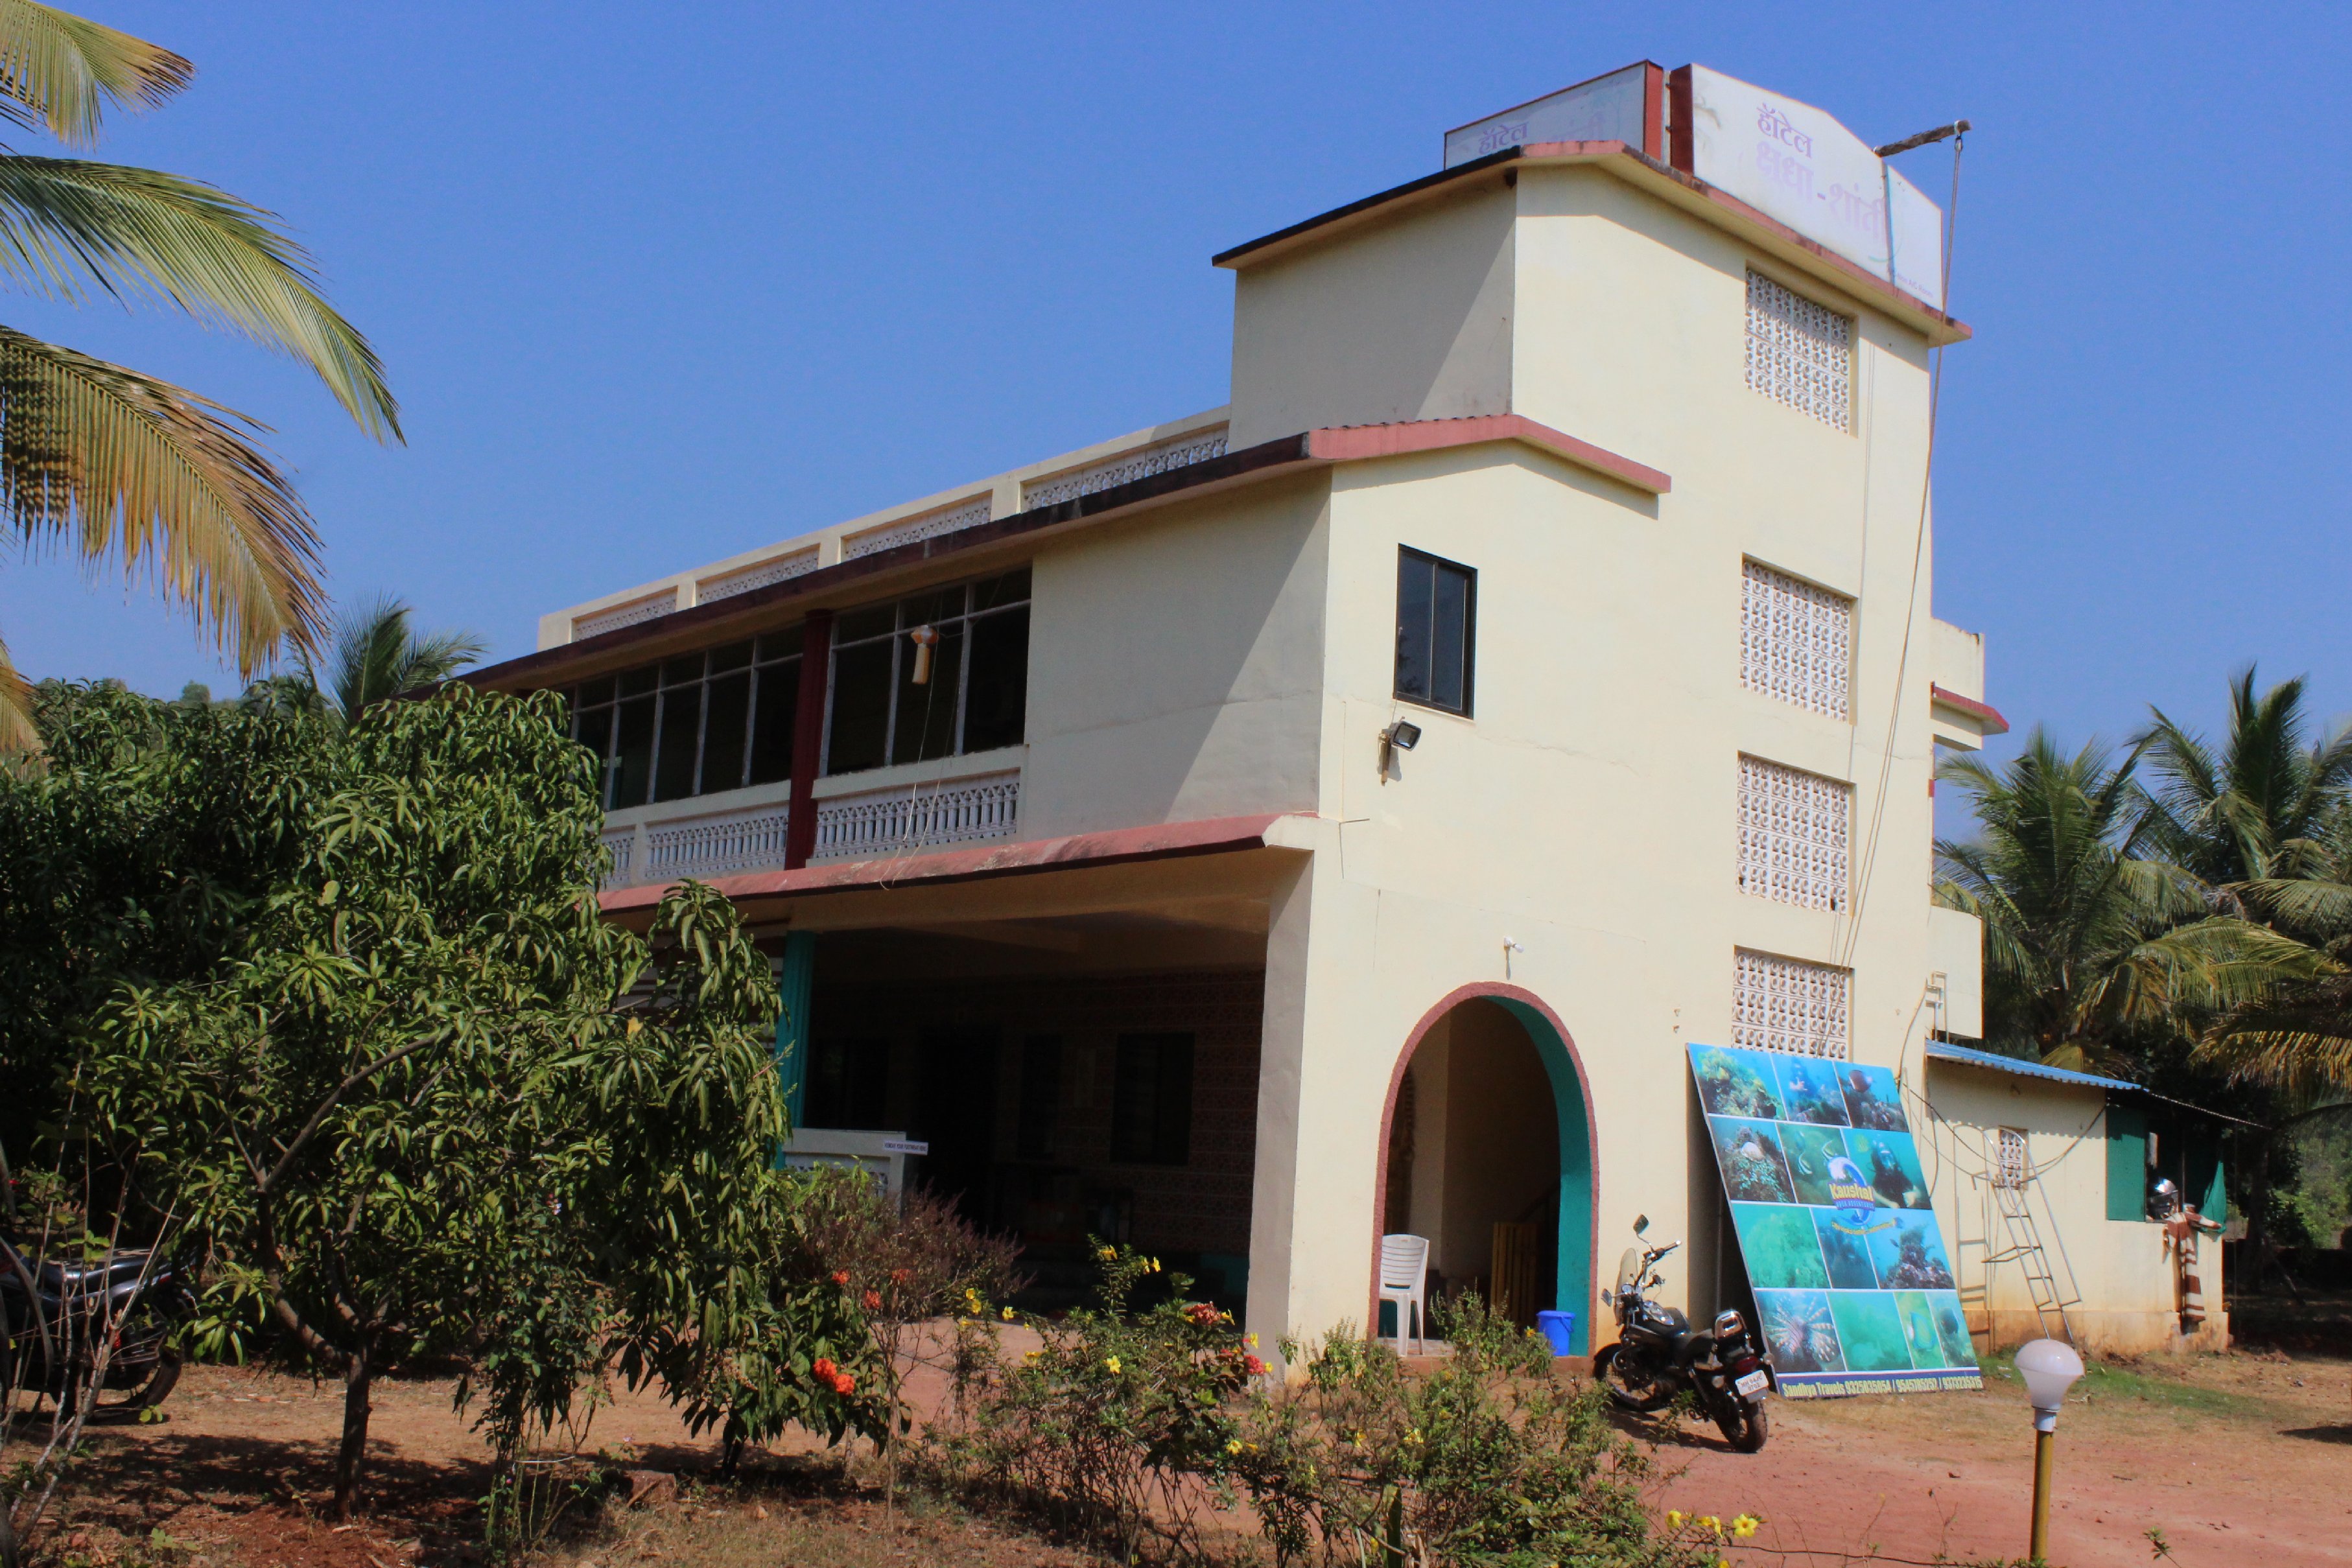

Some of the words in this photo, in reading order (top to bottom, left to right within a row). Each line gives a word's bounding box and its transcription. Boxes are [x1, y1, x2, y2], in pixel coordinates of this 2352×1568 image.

[1756, 102, 1813, 159] हॉटेल
[1828, 1182, 1875, 1202] Kaushal
[1782, 1382, 1817, 1398] Sandhya
[1816, 1381, 1846, 1396] Travels
